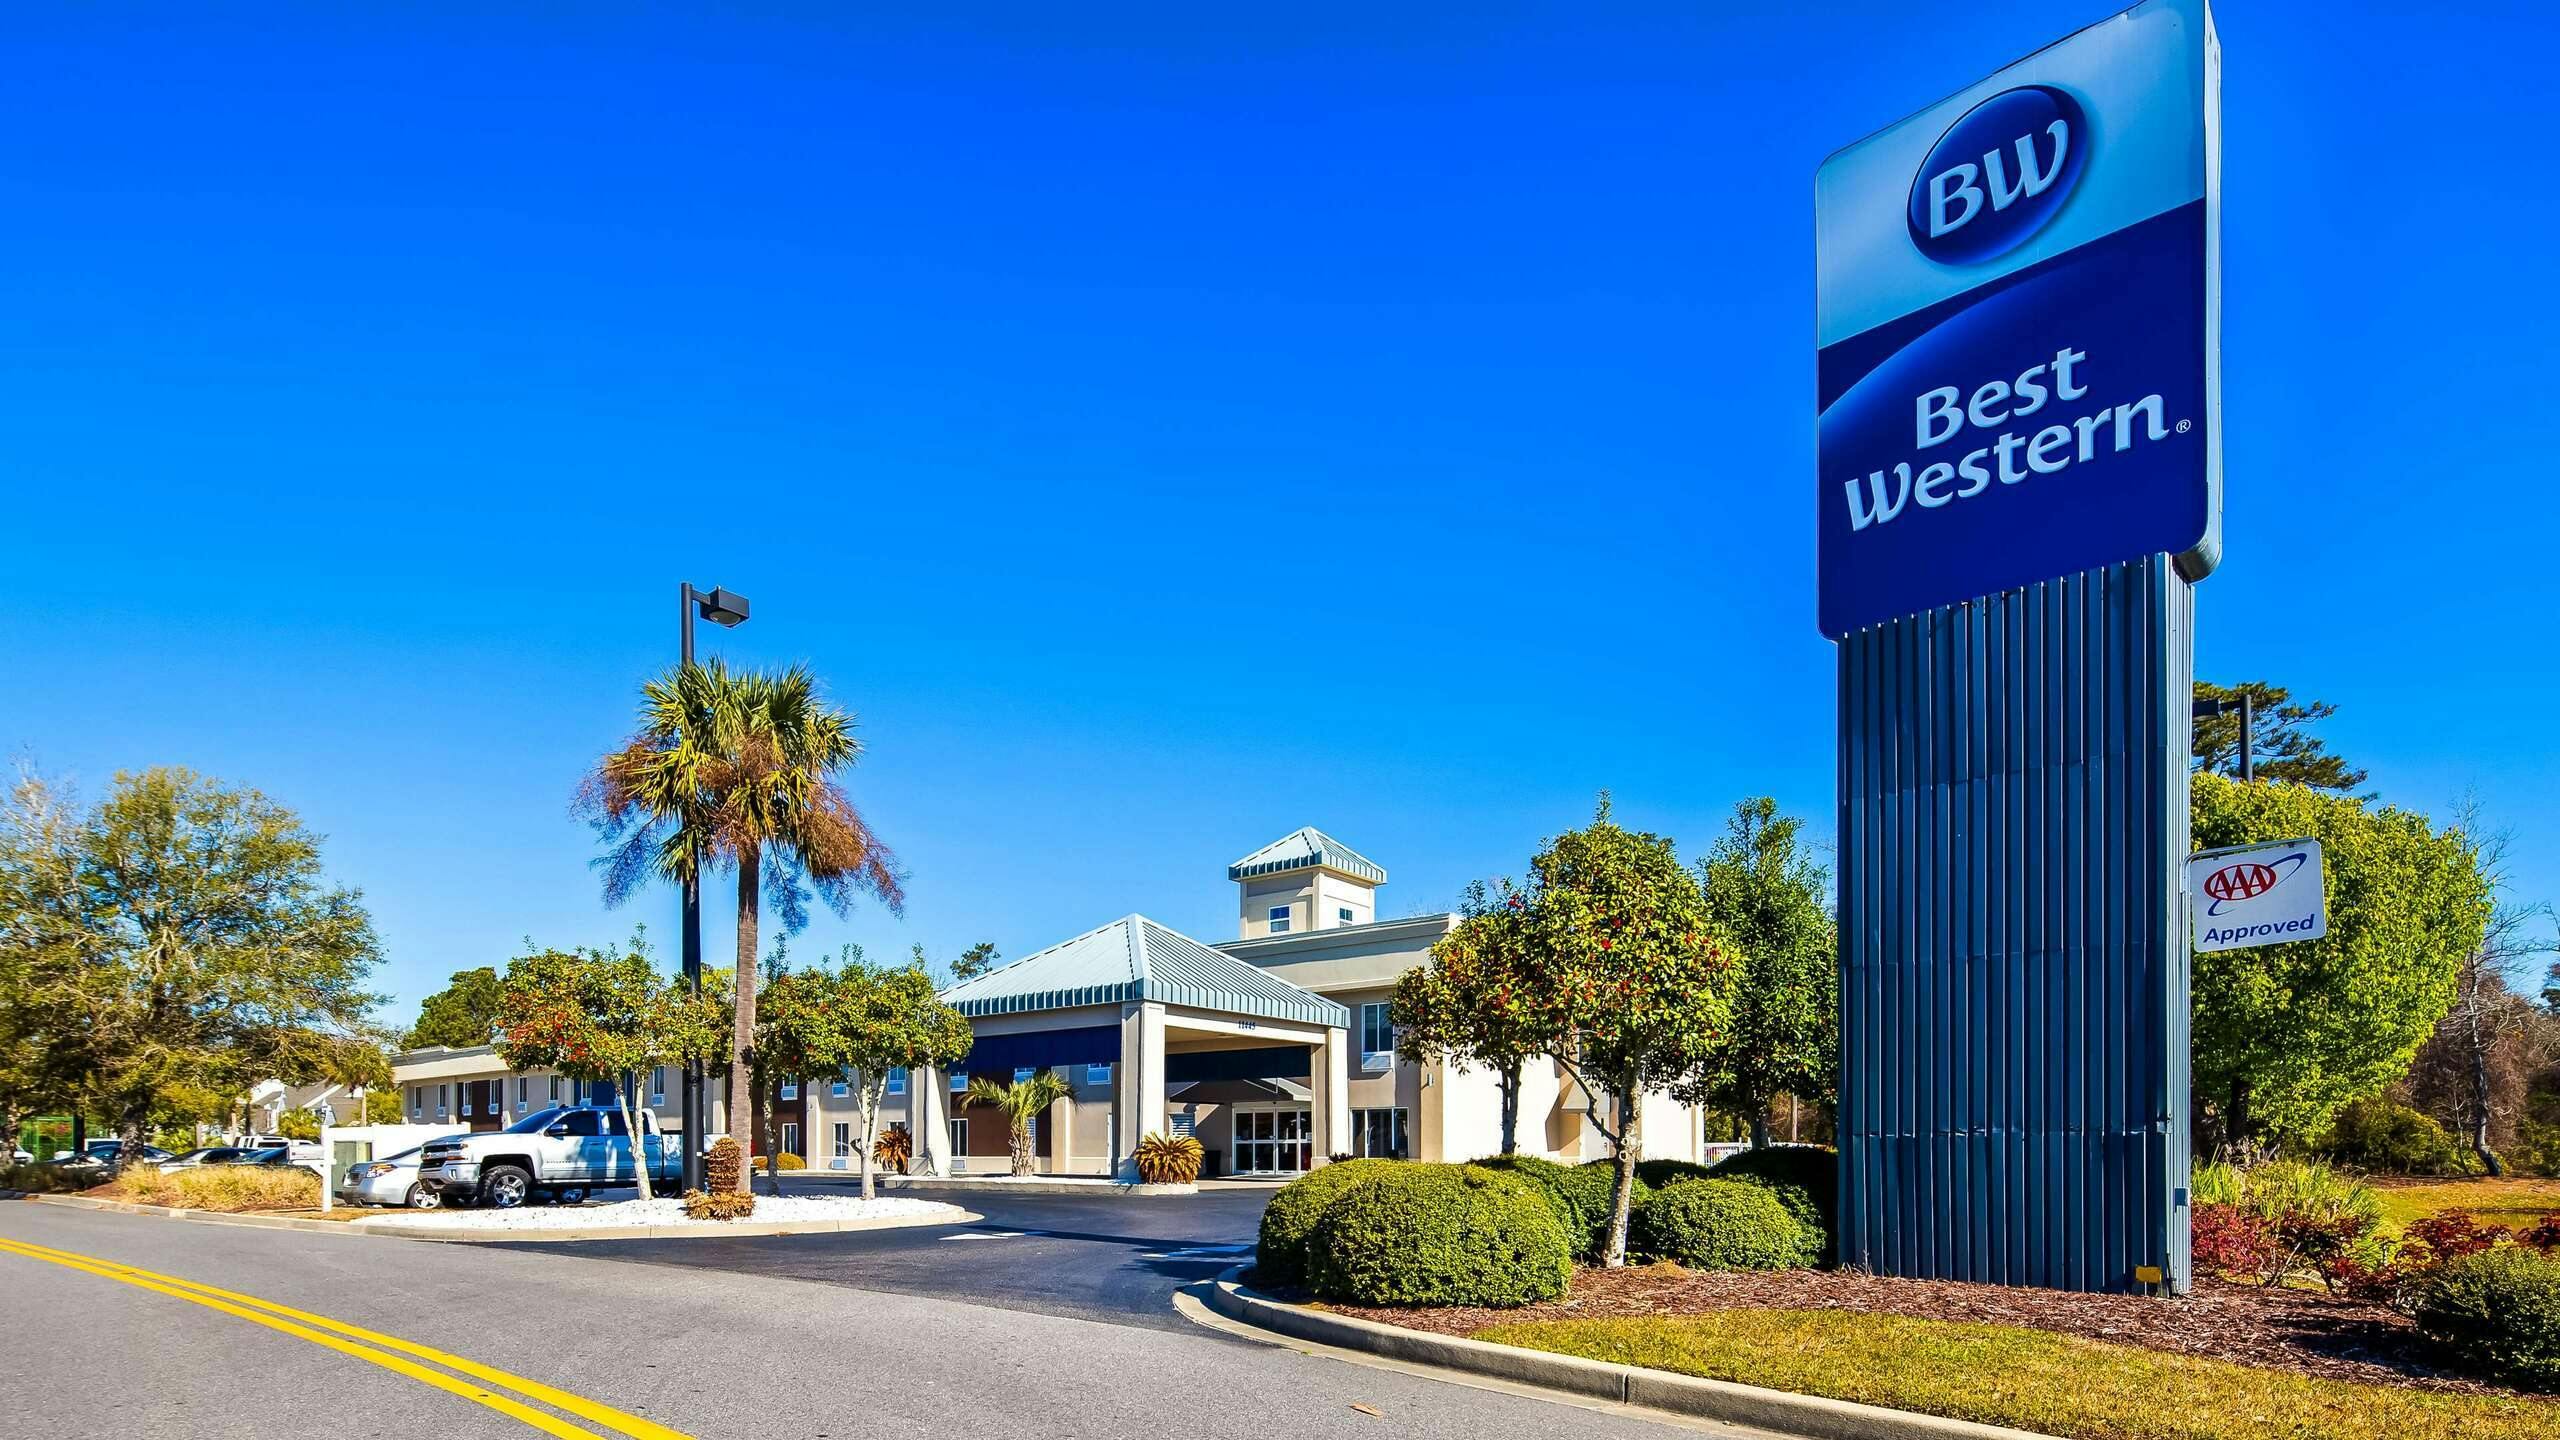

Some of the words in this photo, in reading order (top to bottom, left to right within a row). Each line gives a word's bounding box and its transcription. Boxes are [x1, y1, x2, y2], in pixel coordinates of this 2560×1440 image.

[1929, 119, 2069, 238] BW
[1916, 347, 2088, 451] Best
[1844, 394, 2170, 532] Western
[2204, 914, 2315, 944] Approved
[2208, 864, 2273, 899] AAA
